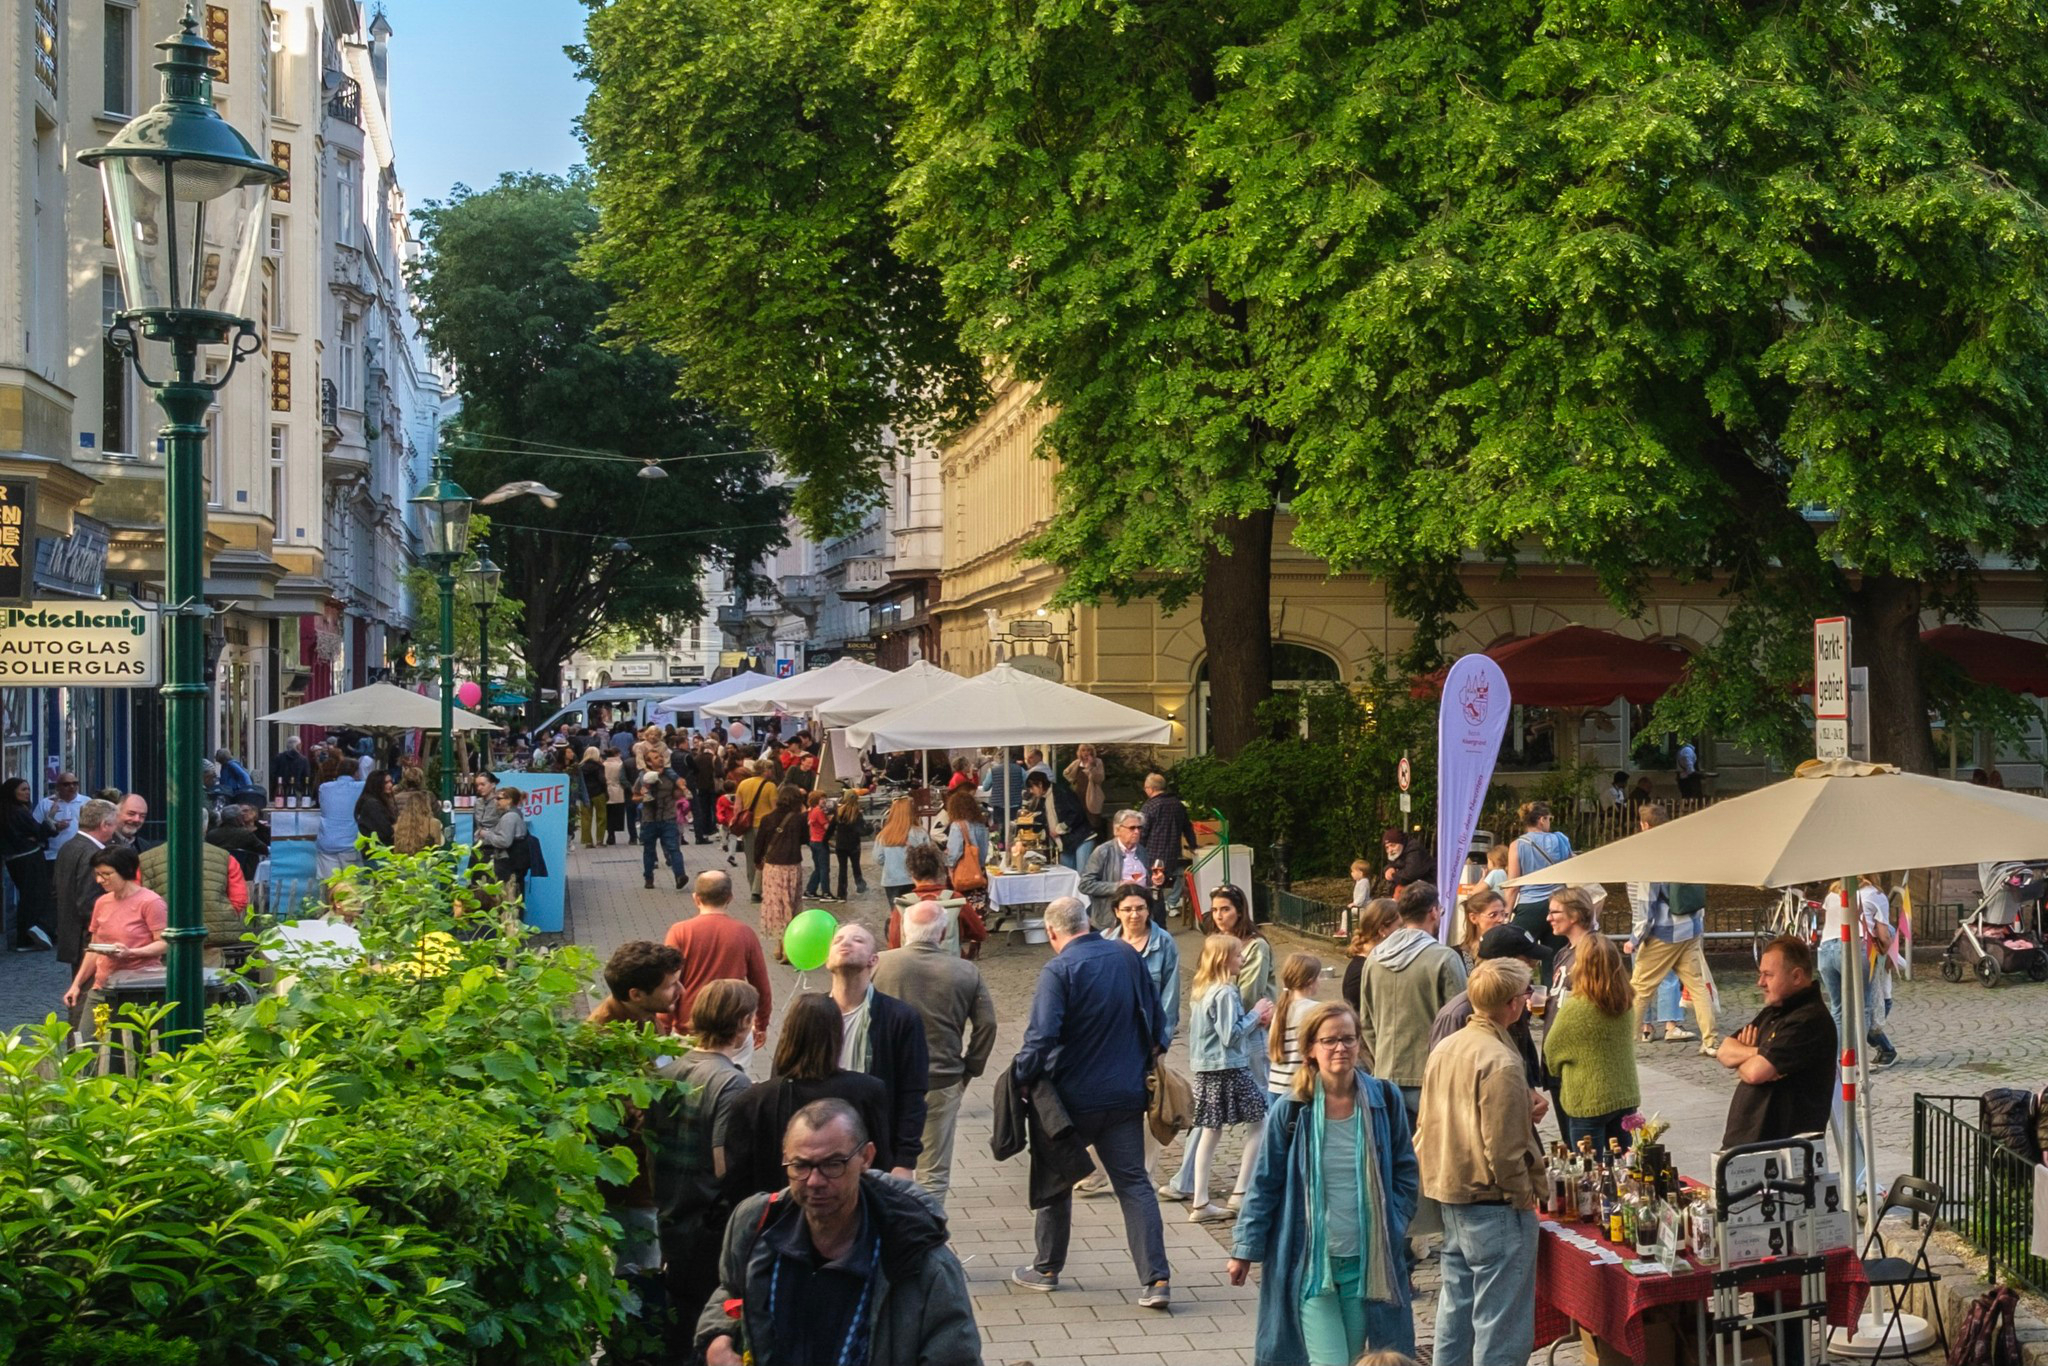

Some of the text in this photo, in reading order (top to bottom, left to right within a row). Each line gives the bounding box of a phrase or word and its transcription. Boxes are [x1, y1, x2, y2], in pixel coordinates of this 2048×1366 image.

[8, 608, 146, 636] Petschenig
[1818, 633, 1843, 661] Markt-
[1818, 672, 1844, 707] gebiet
